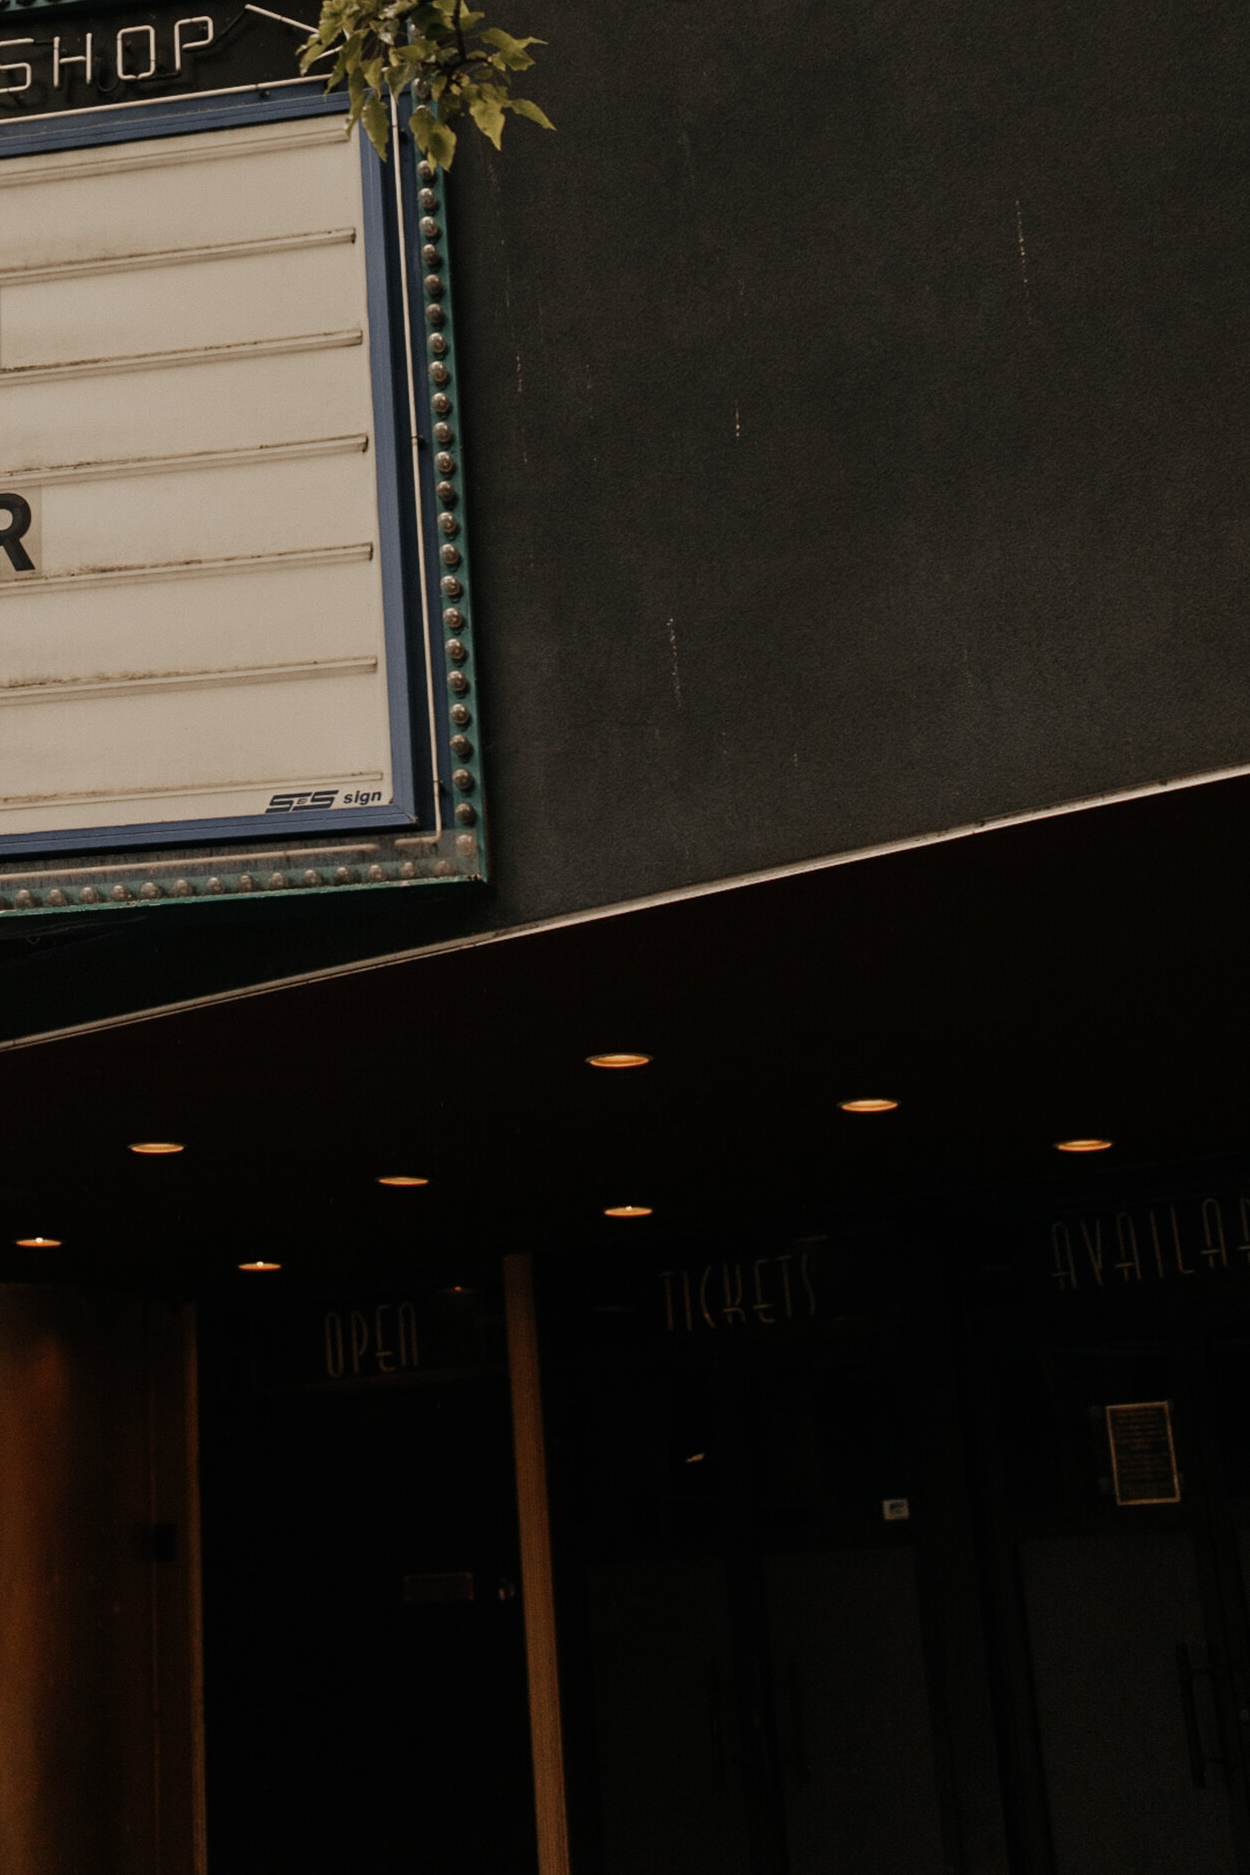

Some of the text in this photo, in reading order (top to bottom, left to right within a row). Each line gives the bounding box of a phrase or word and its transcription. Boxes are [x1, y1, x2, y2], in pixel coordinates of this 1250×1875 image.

[344, 790, 382, 806] sign
[659, 1252, 816, 1331] TICKETS
[324, 1302, 419, 1378] OPEN
